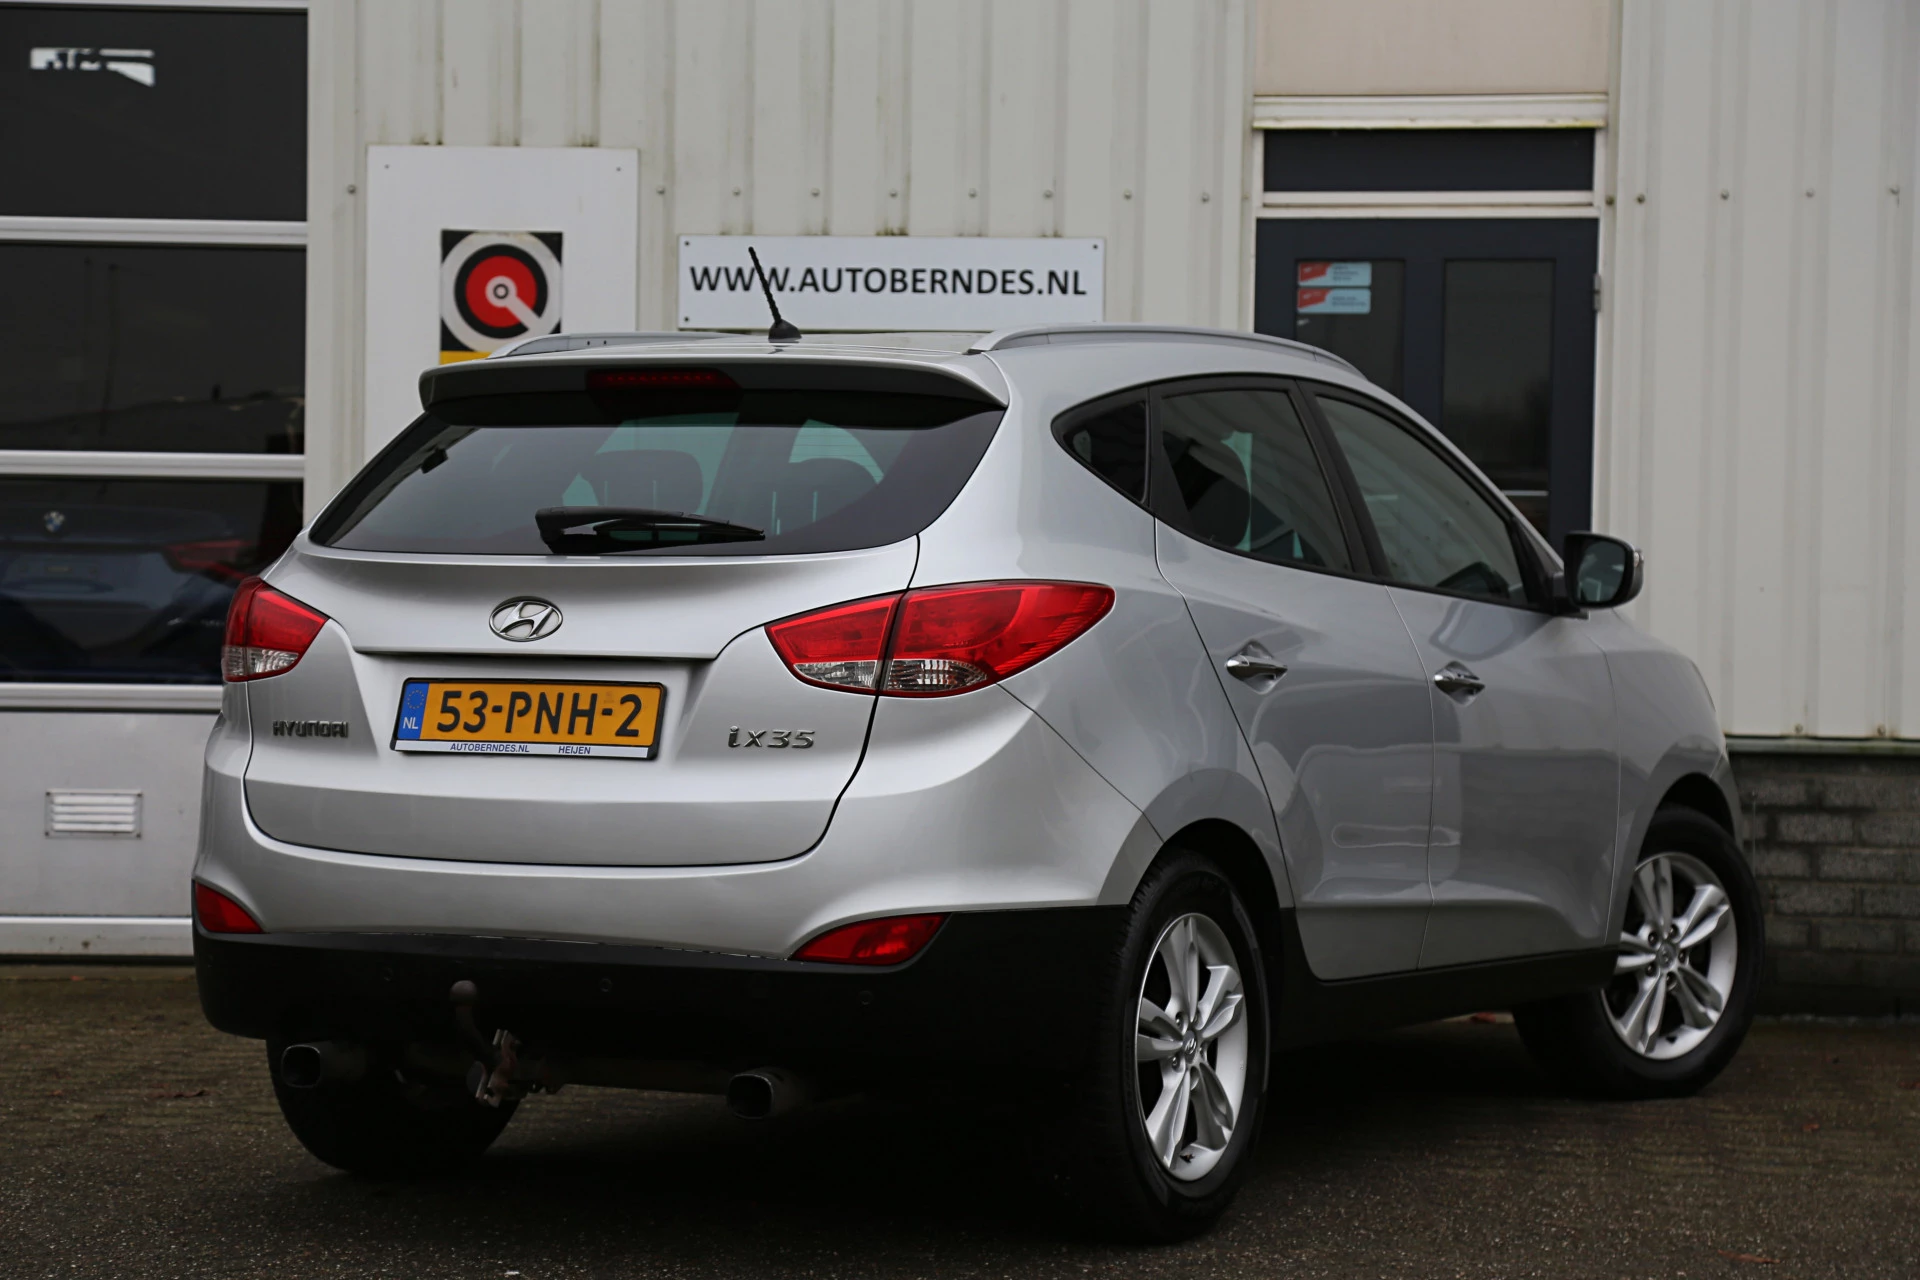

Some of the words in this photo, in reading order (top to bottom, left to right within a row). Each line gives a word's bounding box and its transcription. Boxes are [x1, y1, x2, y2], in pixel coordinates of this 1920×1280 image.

[690, 266, 1087, 295] WWW.AUTOBERNDES.NL
[402, 716, 419, 729] NL
[436, 690, 642, 738] 53-PNH-2
[273, 720, 349, 738] HYUNDAI
[728, 725, 815, 748] ix35
[450, 742, 530, 753] AUTOBERNDES.NL
[558, 745, 591, 755] HEIJEN
